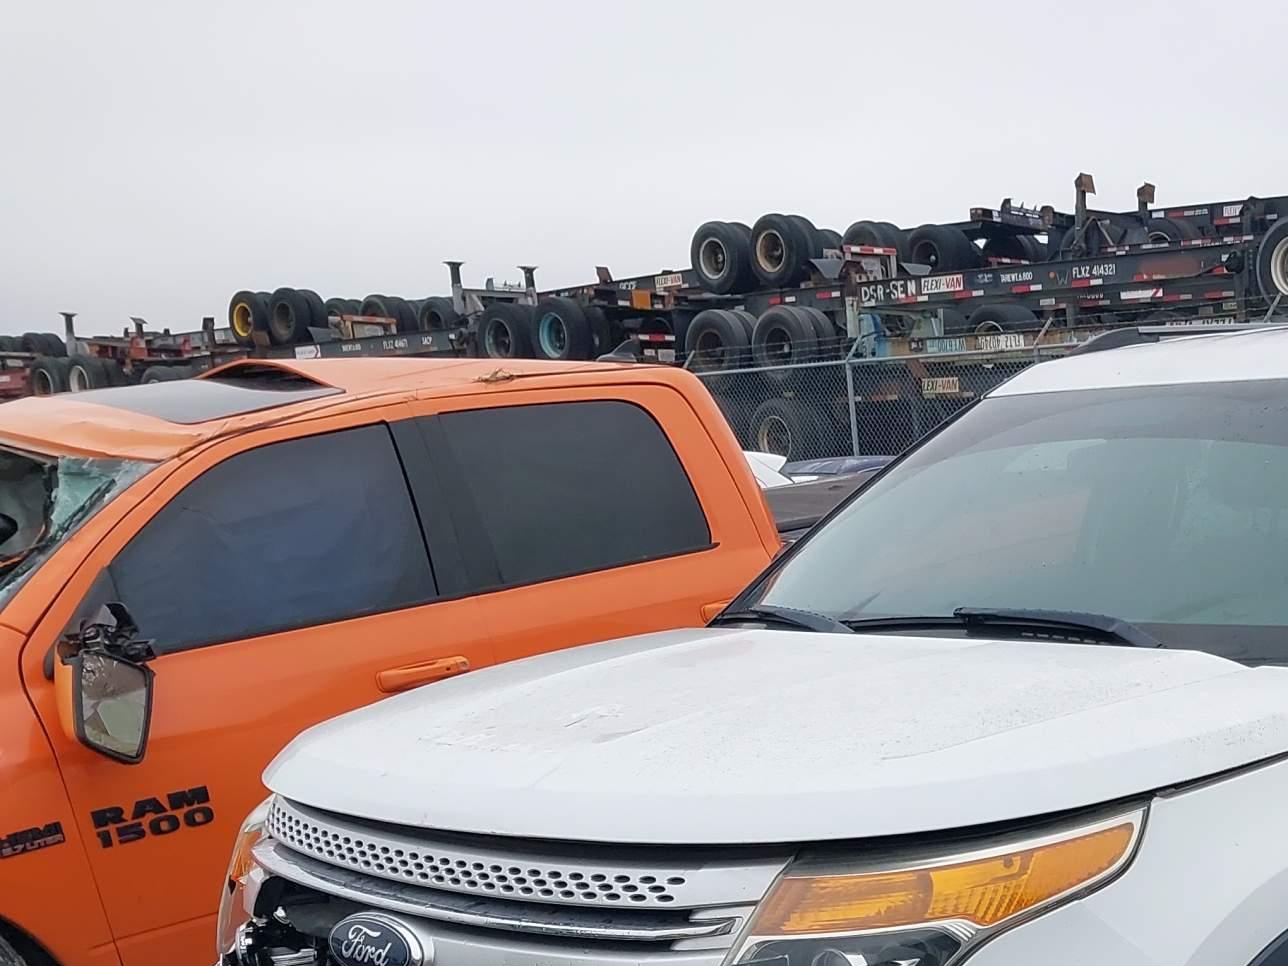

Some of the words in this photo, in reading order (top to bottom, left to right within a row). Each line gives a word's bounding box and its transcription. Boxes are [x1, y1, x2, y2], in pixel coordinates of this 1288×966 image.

[923, 276, 962, 291] FLEXI-VAN
[1072, 266, 1090, 279] FLXZ
[1092, 263, 1116, 276] 414321
[922, 378, 958, 392] LEXI-VAN
[90, 785, 210, 828] RAM
[96, 806, 215, 848] 1500
[341, 924, 393, 966] Ford
